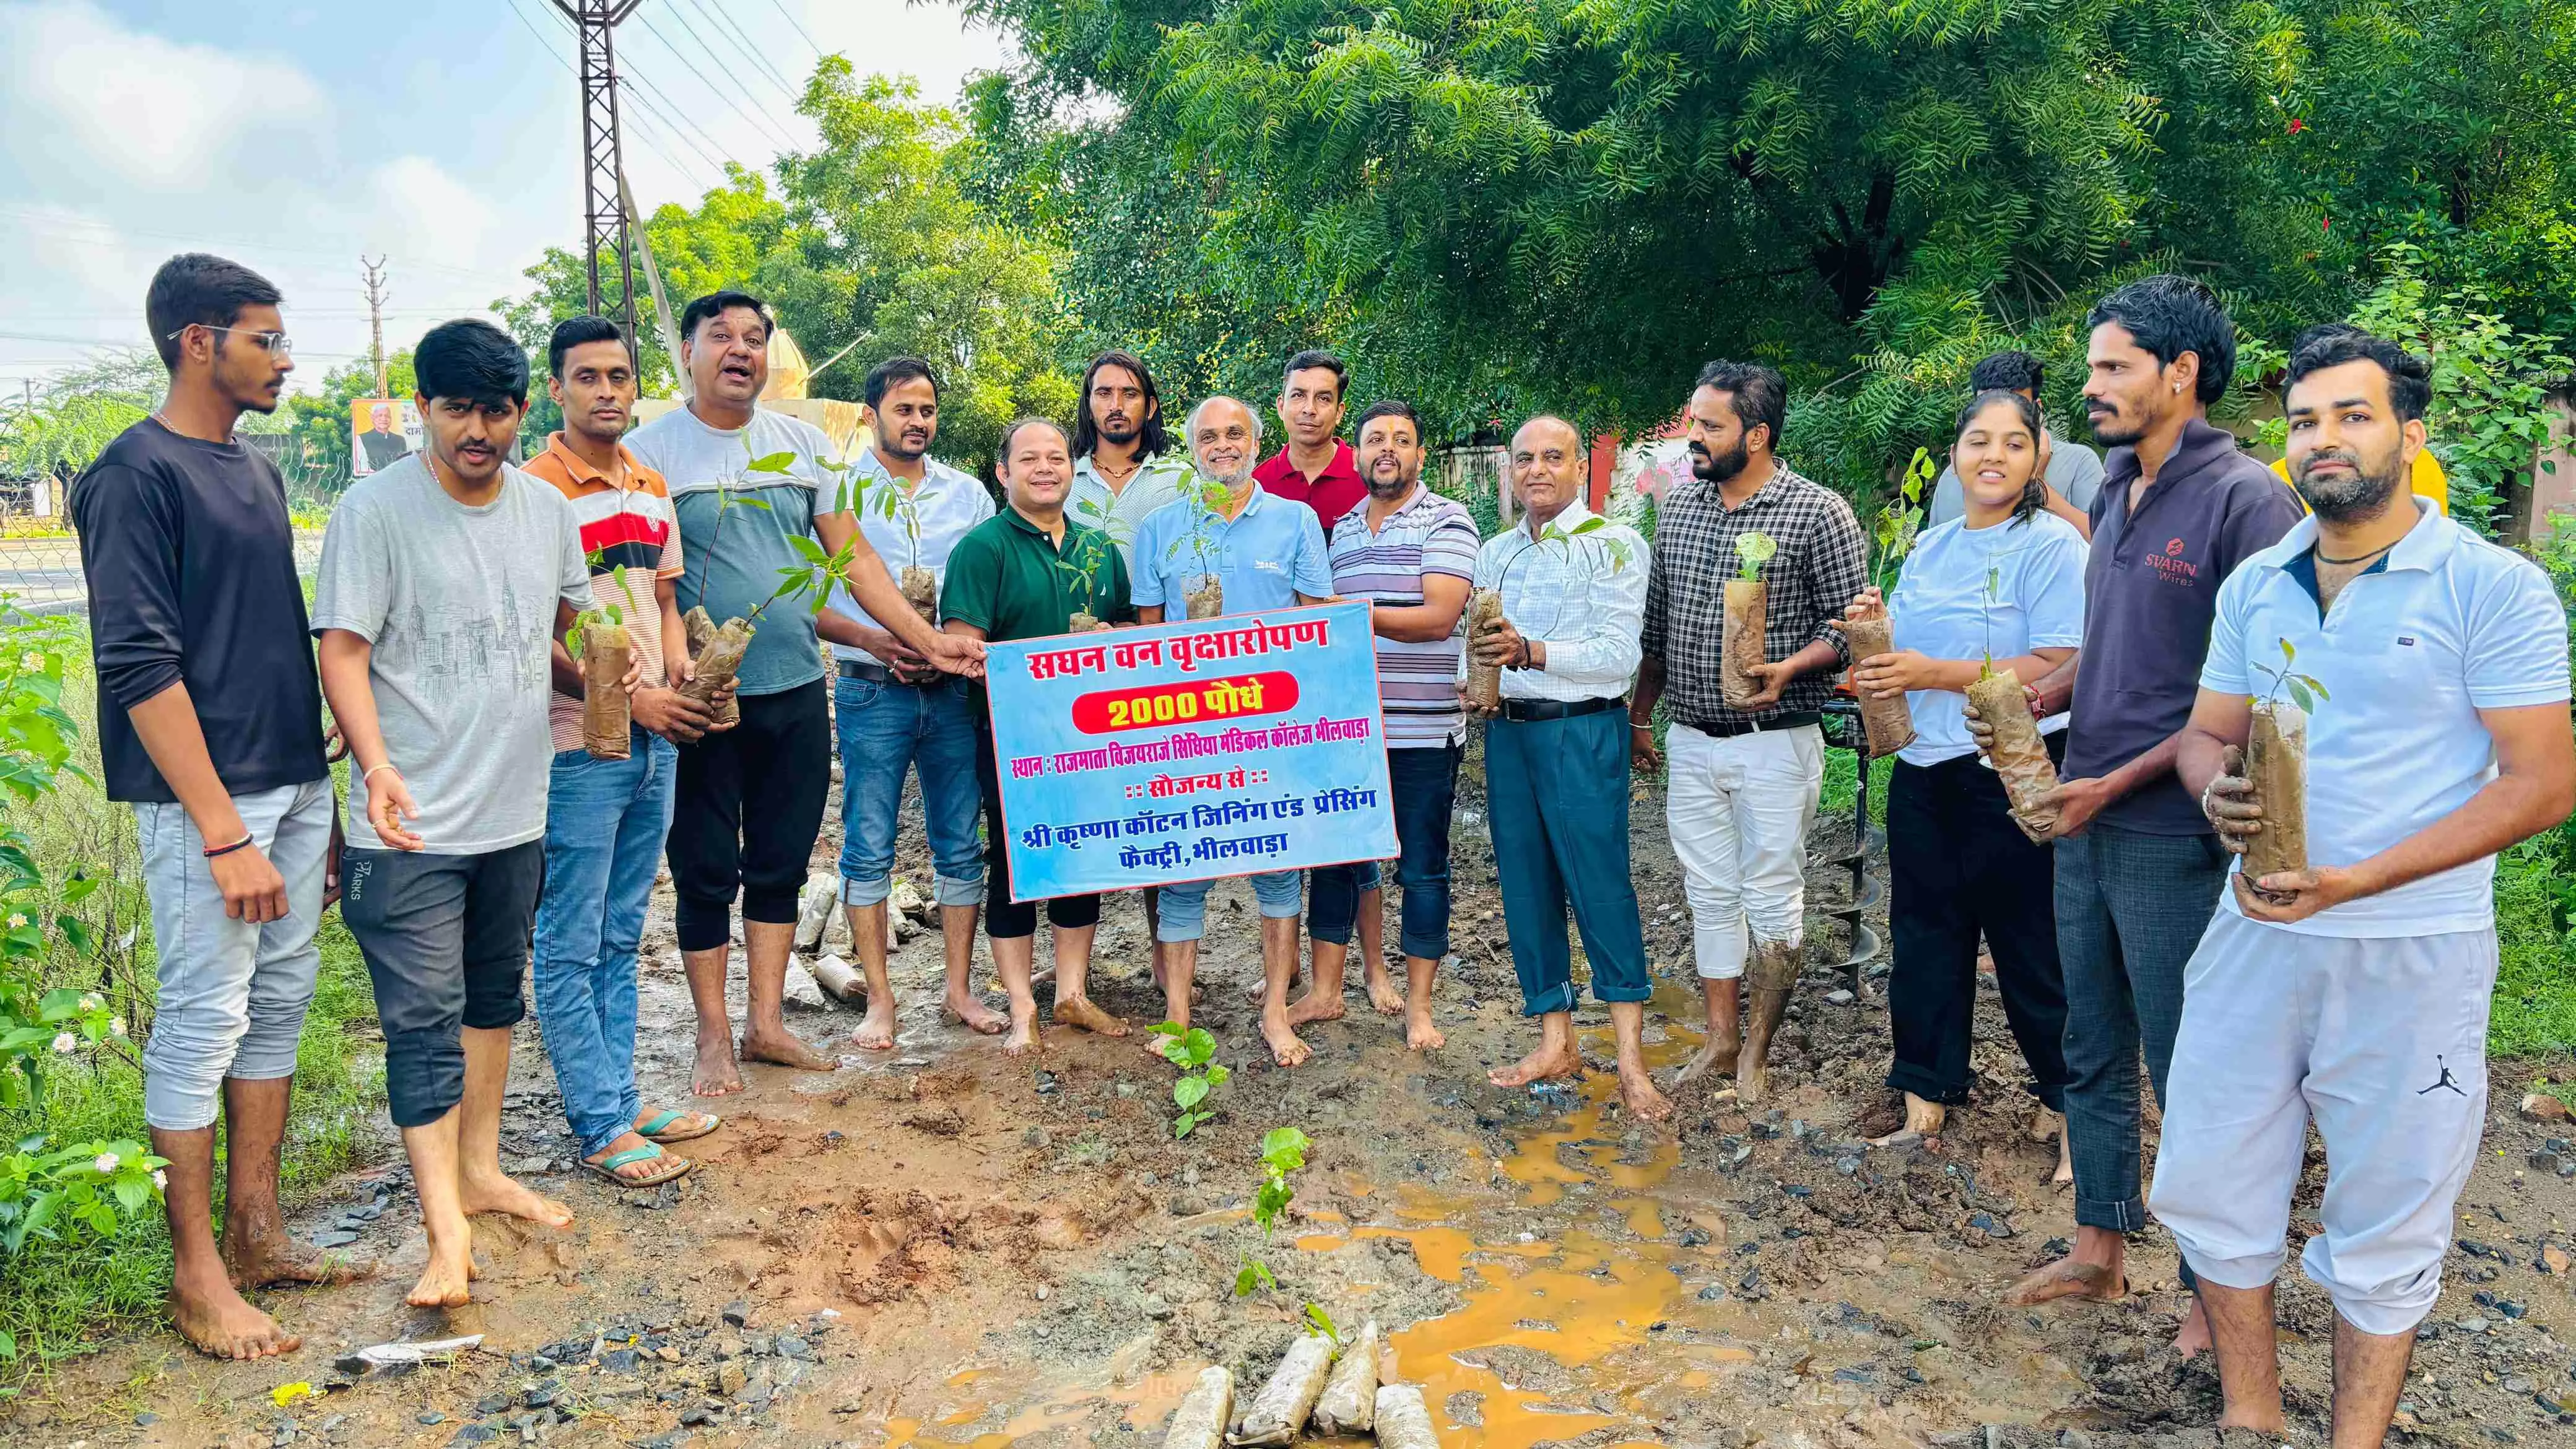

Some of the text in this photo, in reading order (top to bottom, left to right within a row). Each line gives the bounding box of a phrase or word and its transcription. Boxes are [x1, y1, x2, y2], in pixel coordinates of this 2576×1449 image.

[2145, 554, 2197, 576] SVARN
[2159, 570, 2194, 587] Wires
[1026, 619, 1329, 679] सघन वन वृक्षारोपण
[1108, 677, 1264, 726] 2000 पौधे
[1011, 757, 1043, 778] स्थान
[1053, 748, 1108, 774] राजमाता
[1108, 734, 1170, 767] विजयराजे
[1219, 727, 1269, 754] मेडिकल
[1270, 718, 1313, 748] कॉलेज
[1315, 716, 1370, 744] भीलवाड़ा
[1147, 773, 1223, 799] सौजन्य
[1225, 765, 1246, 788] से
[1022, 785, 1377, 850] श्री कृष्णा कॉटन जिनिंग एंड प्रेसिंग
